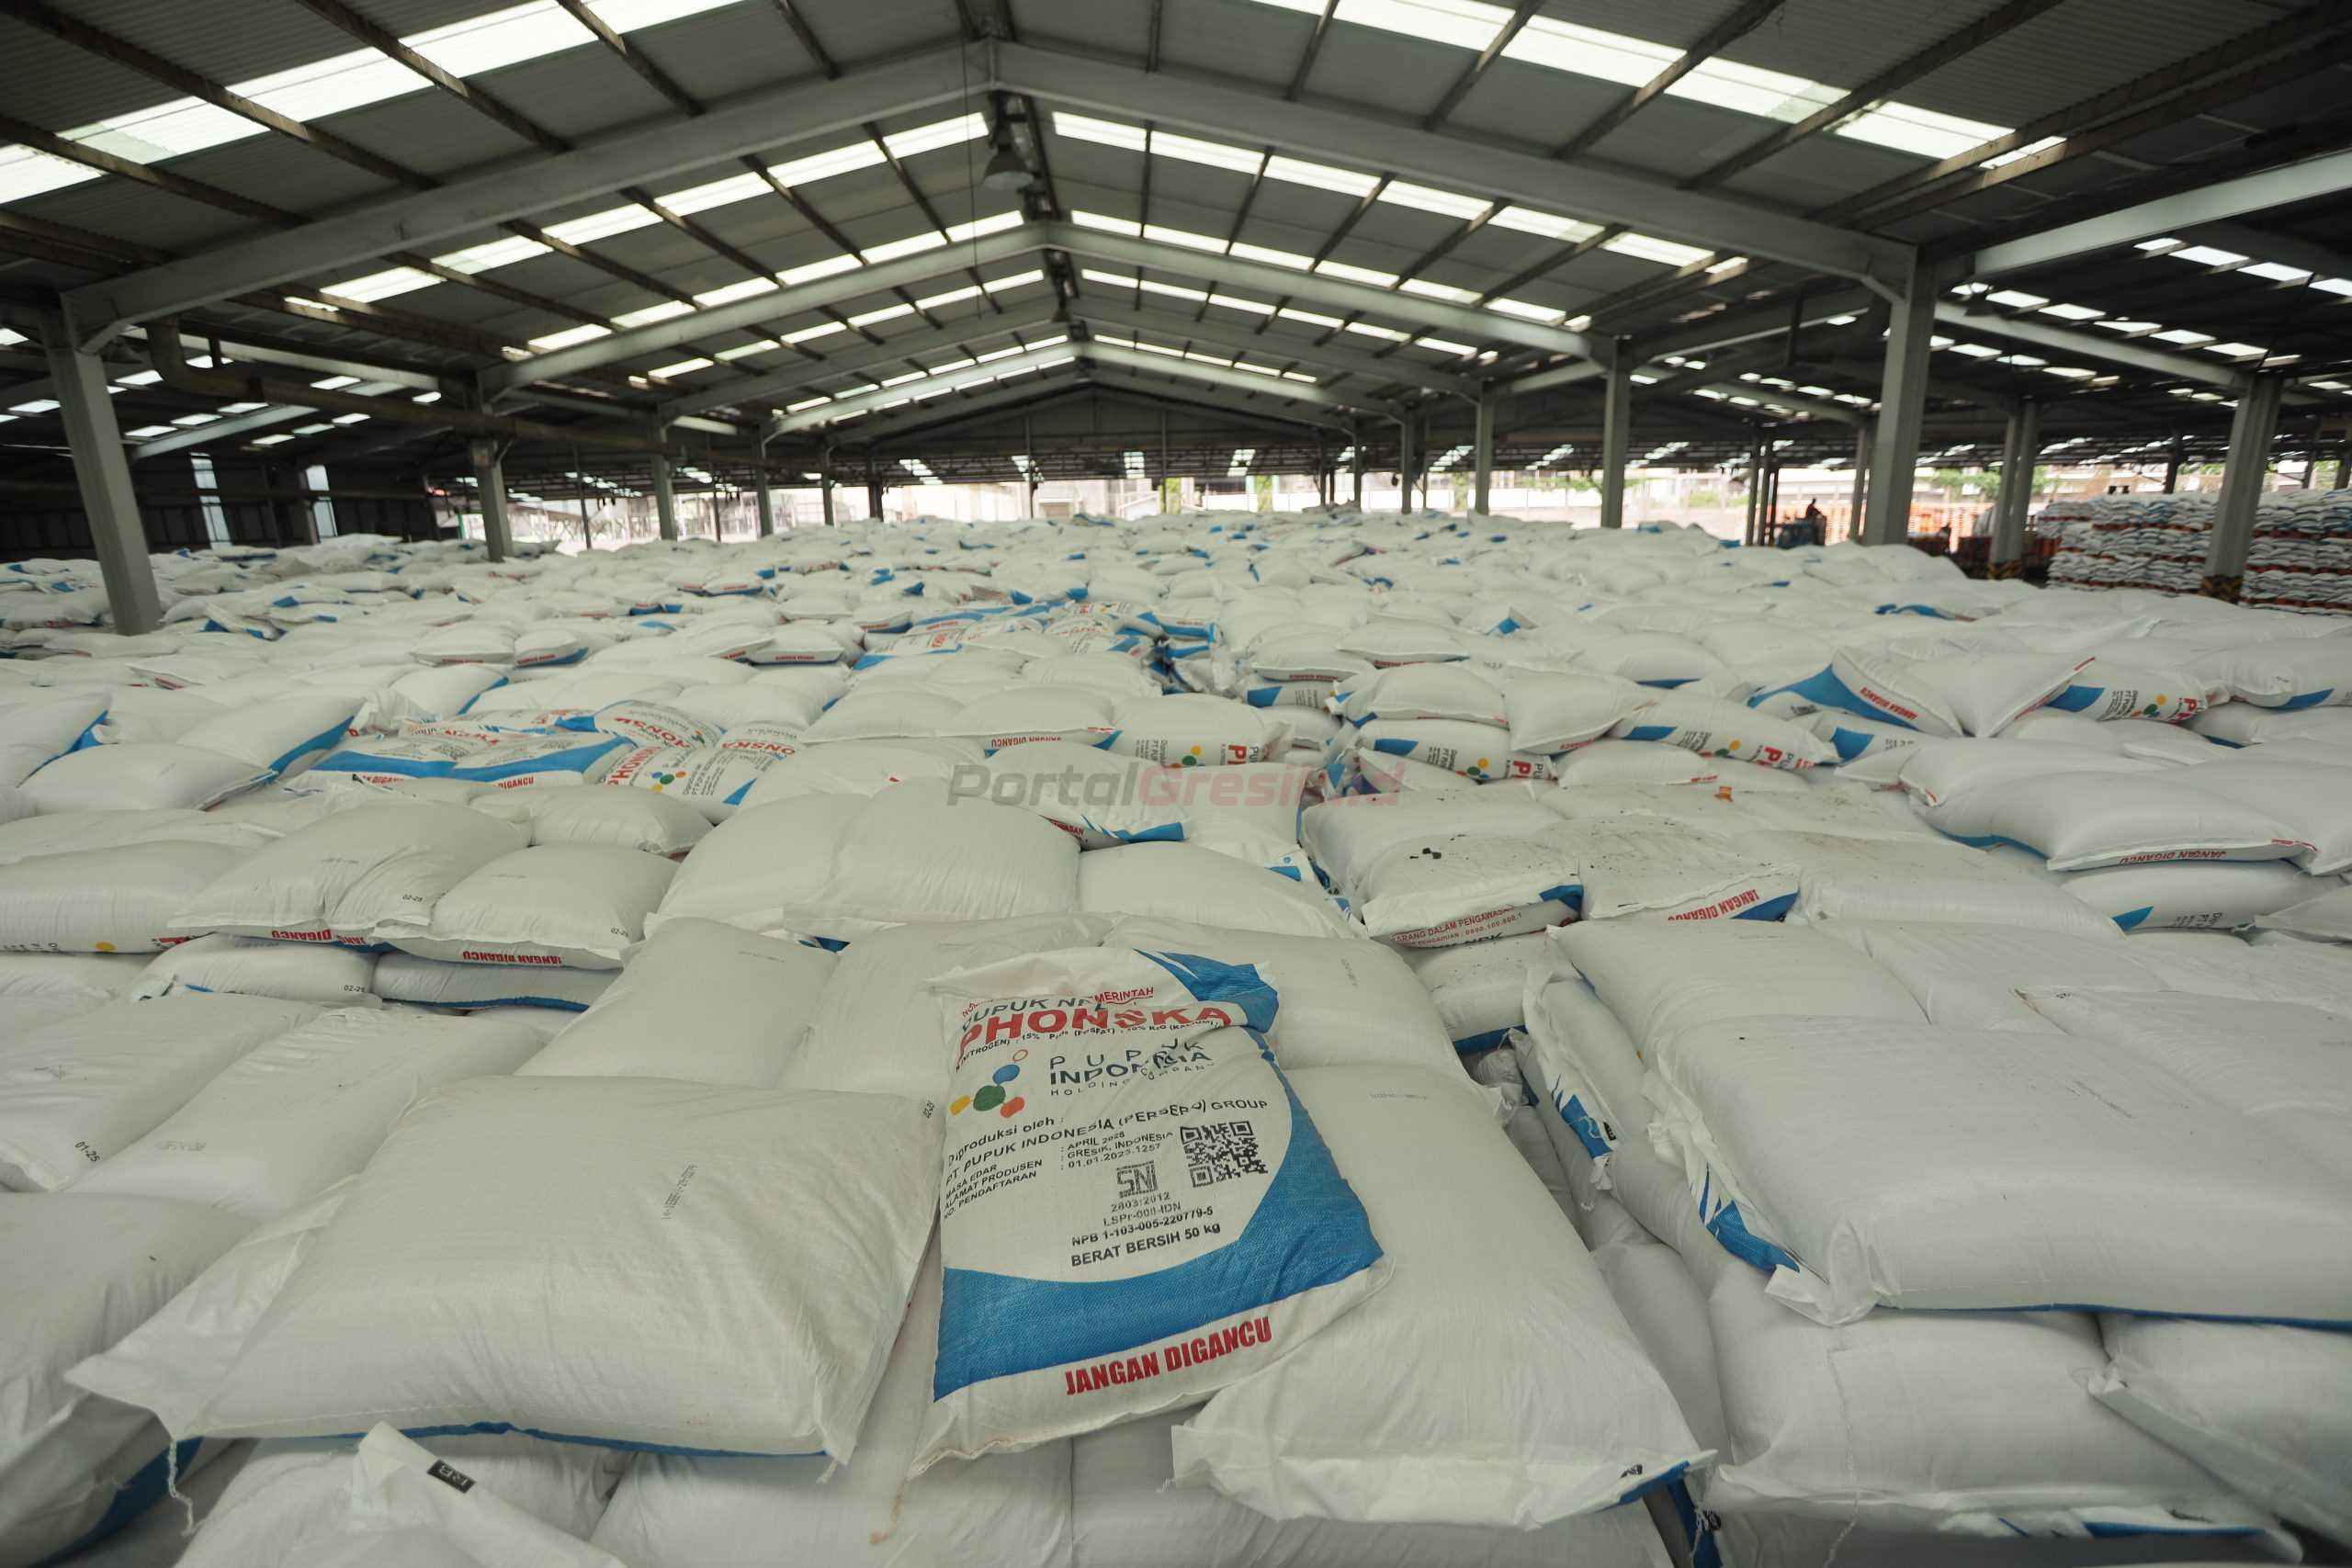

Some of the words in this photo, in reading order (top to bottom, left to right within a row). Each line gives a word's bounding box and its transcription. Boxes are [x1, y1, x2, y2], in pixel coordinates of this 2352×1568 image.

[1717, 888, 1759, 914] JANGAN
[271, 929, 332, 942] DIGANCU
[1426, 921, 1456, 936] DALAM
[462, 951, 515, 964] DIGANCU
[517, 954, 562, 964] JANGAN
[957, 1007, 1231, 1068] PHONSKA
[75, 1141, 100, 1163] 01-25
[946, 1168, 959, 1187] PT
[964, 1143, 1016, 1173] PUPUK
[1022, 1118, 1114, 1149] INDONESIA
[1211, 1100, 1268, 1111] GROUP
[948, 1125, 1017, 1167] Diproduksi
[1023, 1117, 1055, 1133] oleh
[944, 1182, 978, 1212] ALAMAT
[981, 1158, 1043, 1187] PRODUSEN
[1114, 1132, 1174, 1149] INDONESIA
[945, 1179, 967, 1201] MASA
[970, 1164, 998, 1182] EDAR
[1067, 1137, 1099, 1150] APRIL
[959, 1170, 1036, 1208] PENDAFTARAN
[1071, 1233, 1099, 1247] NPB
[1102, 1206, 1214, 1240] 1-103-005-220779-5
[1071, 1246, 1122, 1267] BERAT
[1126, 1231, 1181, 1254] BERSIH
[1184, 1227, 1200, 1240] 50
[1204, 1223, 1221, 1235] kg
[1066, 1352, 1159, 1395] JANGAN
[1165, 1315, 1273, 1371] DIGANCU
